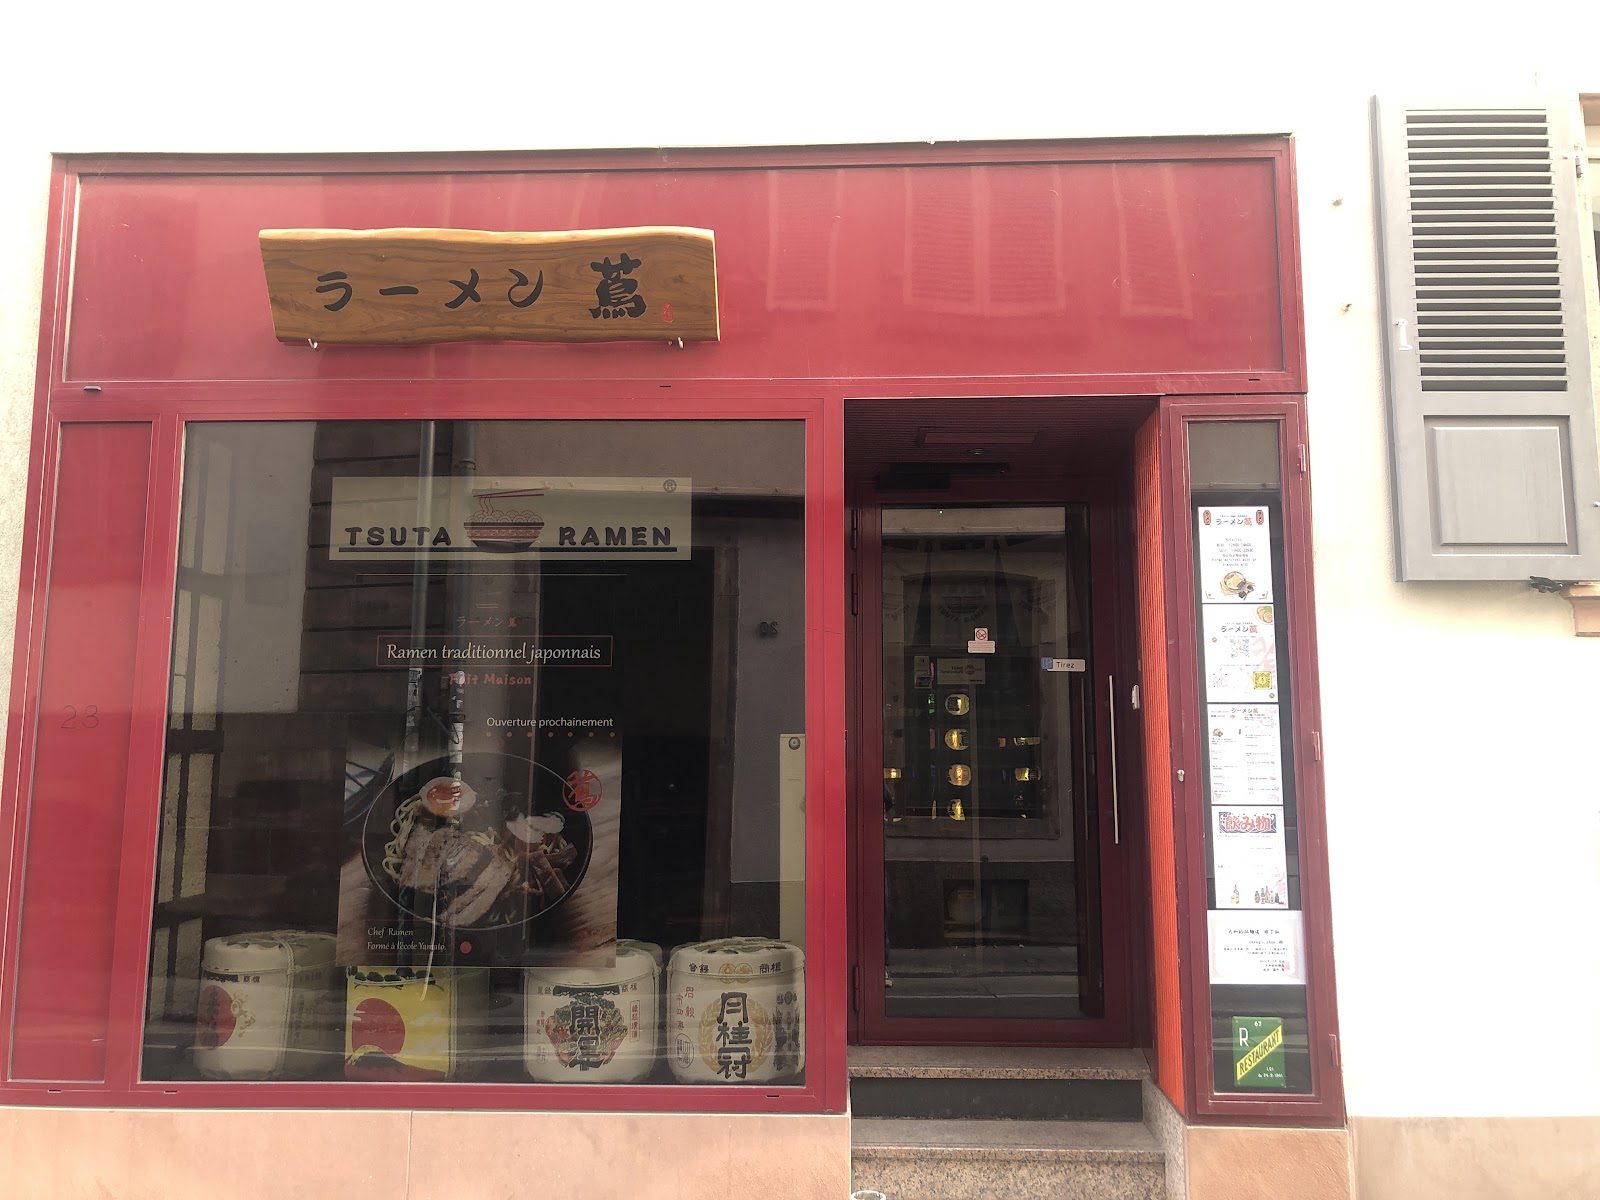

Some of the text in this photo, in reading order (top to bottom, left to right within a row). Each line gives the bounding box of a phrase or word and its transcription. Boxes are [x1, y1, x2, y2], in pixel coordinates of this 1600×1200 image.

[316, 268, 543, 311] ラーメン
[345, 526, 671, 546] TSUTA RAMEN
[387, 642, 601, 664] Ramen traditionnel japonnais
[1056, 660, 1075, 669] Tirez
[484, 673, 532, 685] Maison
[487, 716, 614, 730] Ouverture prochainement
[367, 927, 414, 938] Chef Ramen
[715, 991, 752, 1079] 月桂冠
[1238, 1027, 1249, 1047] R
[1239, 1028, 1281, 1076] RESTAURANT
